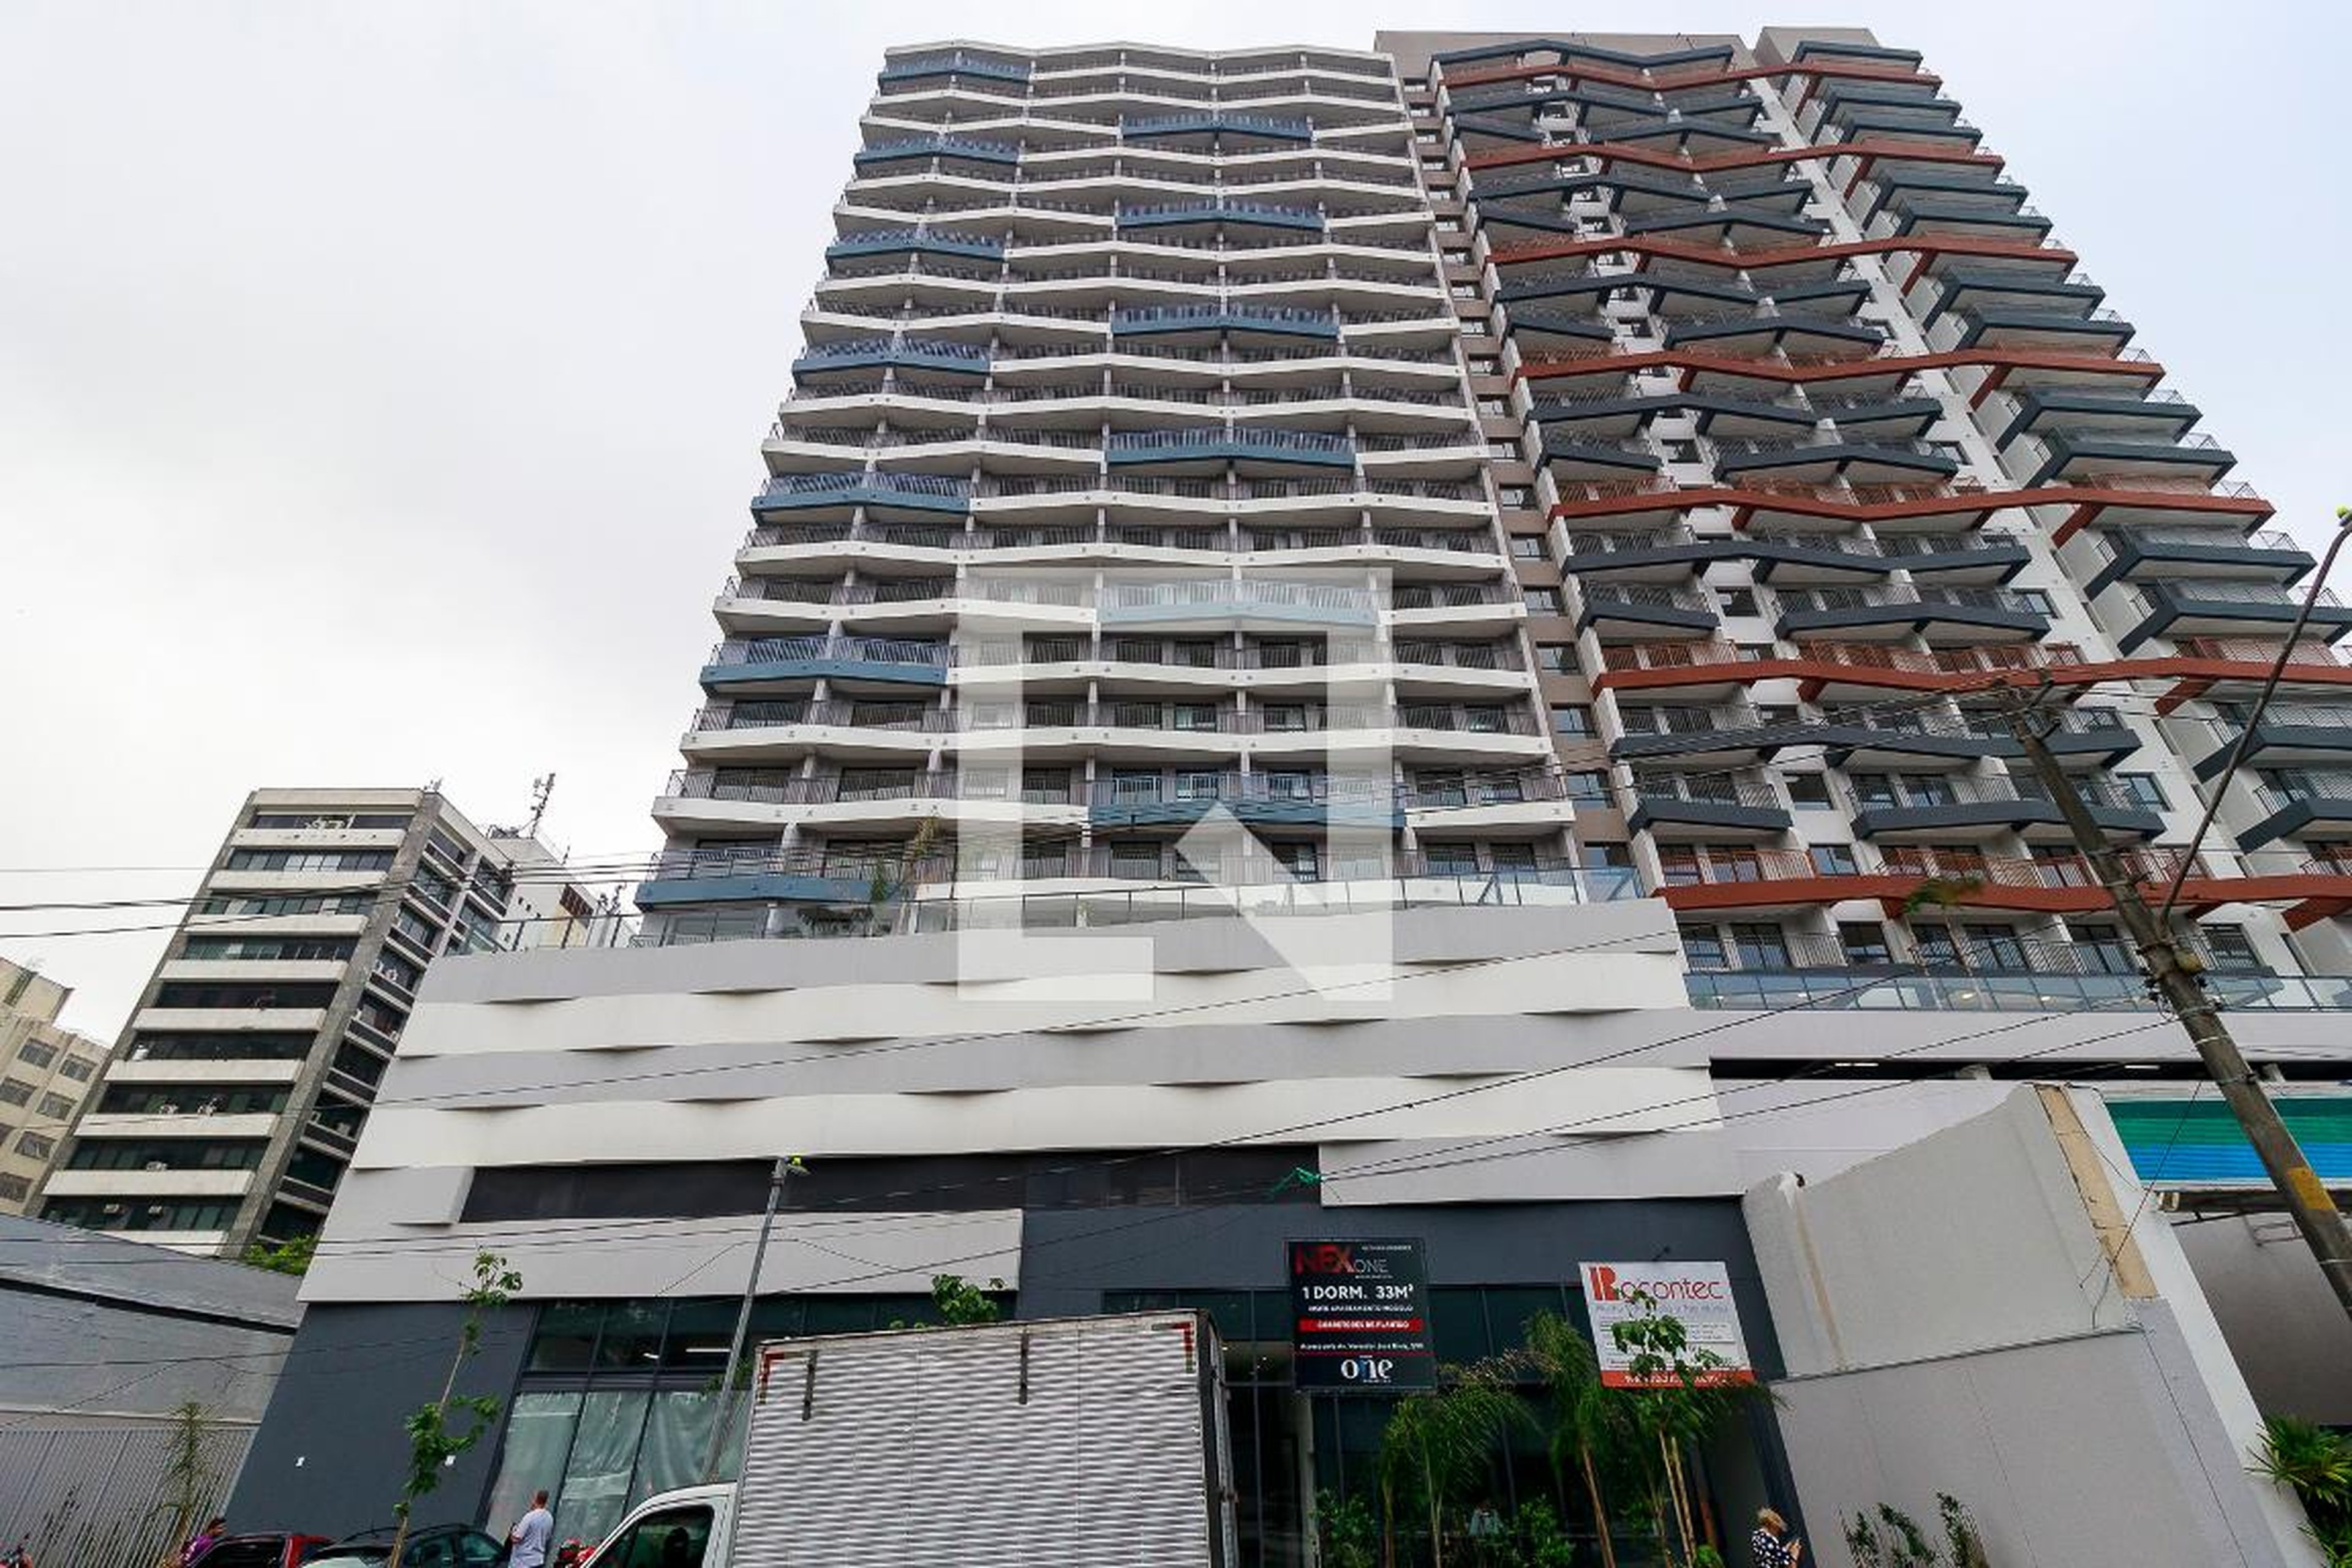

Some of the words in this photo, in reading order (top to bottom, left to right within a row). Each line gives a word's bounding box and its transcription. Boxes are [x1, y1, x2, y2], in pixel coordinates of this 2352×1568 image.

[1354, 1259, 1389, 1273] ONE
[1302, 1287, 1310, 1300] 1
[1314, 1286, 1368, 1300] DORM.
[1341, 1359, 1393, 1379] one
